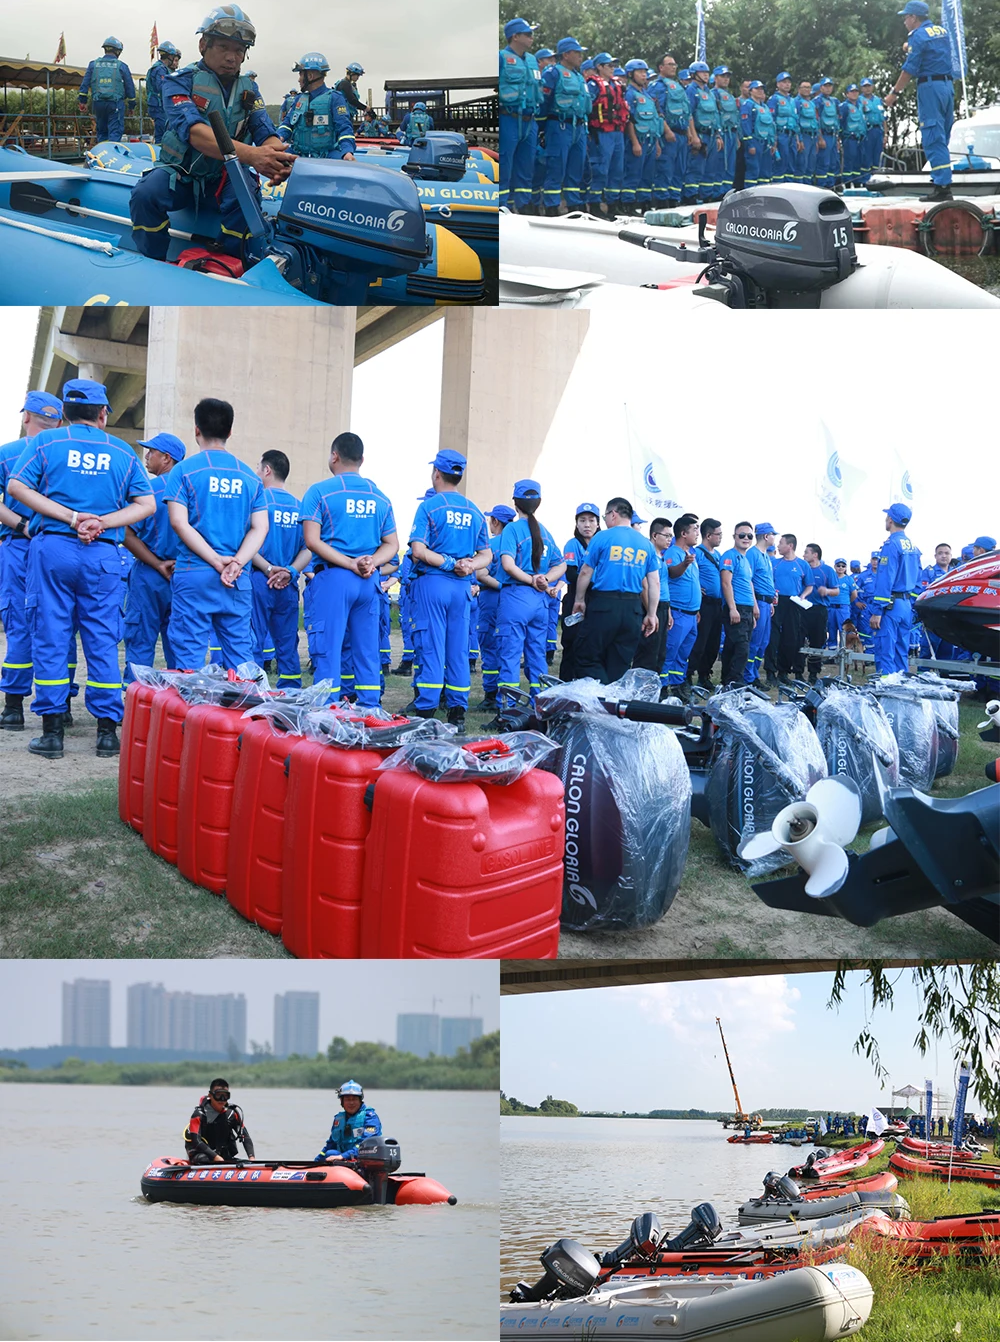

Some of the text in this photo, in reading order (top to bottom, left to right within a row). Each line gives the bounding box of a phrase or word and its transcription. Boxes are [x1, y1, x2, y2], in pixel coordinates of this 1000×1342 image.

[298, 200, 386, 229] CALON GLORIA
[725, 222, 783, 241] CALON GLORIA
[833, 227, 848, 248] 15
[67, 449, 111, 471] BSR
[209, 476, 243, 495] BSR
[346, 498, 377, 514] BSR
[274, 510, 299, 525] BSR
[446, 510, 472, 527] BSR
[609, 545, 648, 566] BSR
[743, 751, 754, 787] ALON
[565, 754, 587, 883] CALON GLORIA
[485, 838, 553, 872] GASOLINE
[389, 1148, 398, 1157] 15
